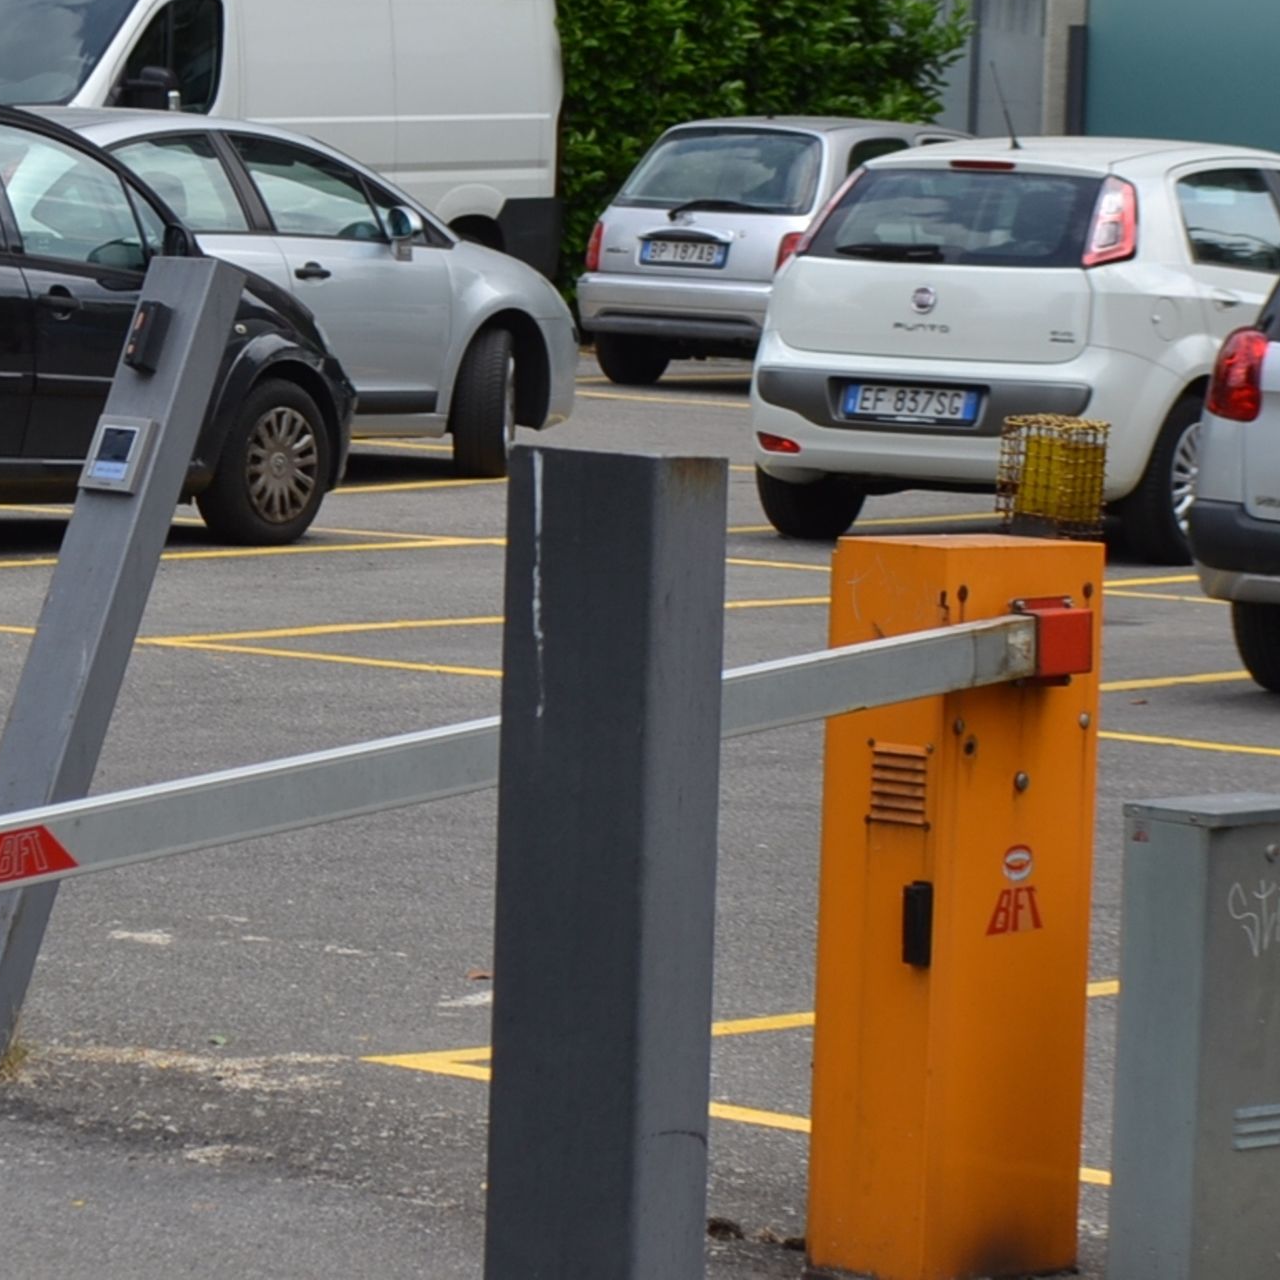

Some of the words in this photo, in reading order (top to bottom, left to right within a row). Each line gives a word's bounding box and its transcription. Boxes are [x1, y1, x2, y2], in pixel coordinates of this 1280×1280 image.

[892, 321, 951, 334] PUNTO
[858, 386, 887, 411] EF
[892, 388, 963, 415] 837SG
[985, 885, 1043, 937] BFT
